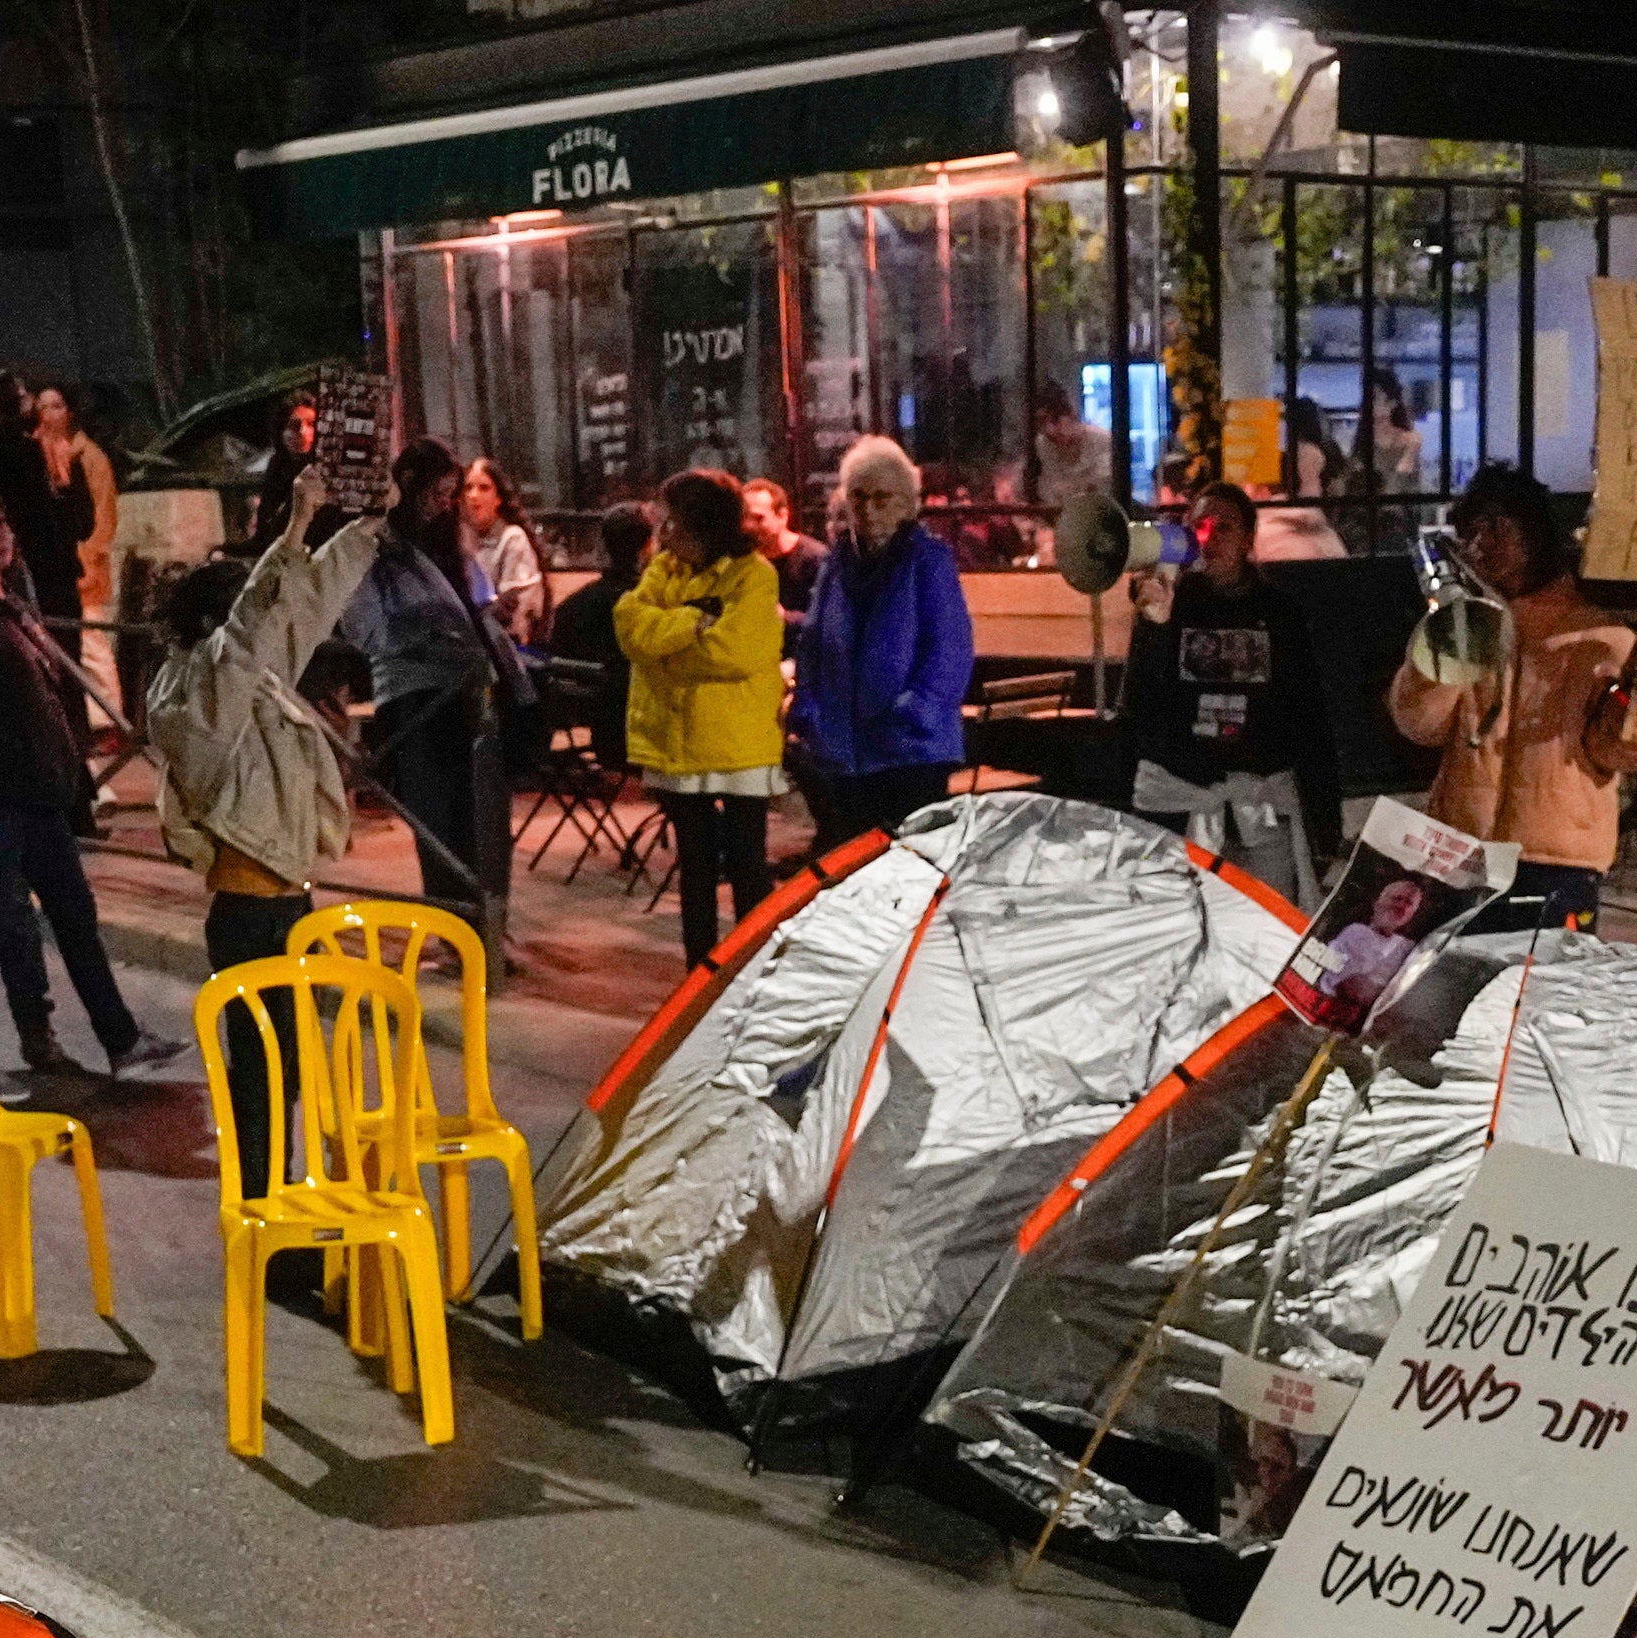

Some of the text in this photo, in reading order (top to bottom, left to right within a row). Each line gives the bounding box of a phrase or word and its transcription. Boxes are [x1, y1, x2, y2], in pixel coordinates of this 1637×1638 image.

[532, 156, 632, 204] FLORA
[1445, 1223, 1620, 1303] אוהבים
[1425, 1290, 1508, 1349] שלנו
[1391, 1358, 1521, 1430] מאשר
[1538, 1398, 1629, 1450] יותר
[1326, 1466, 1629, 1587] שאנחנו שונאים
[1321, 1540, 1486, 1624] החמאס
